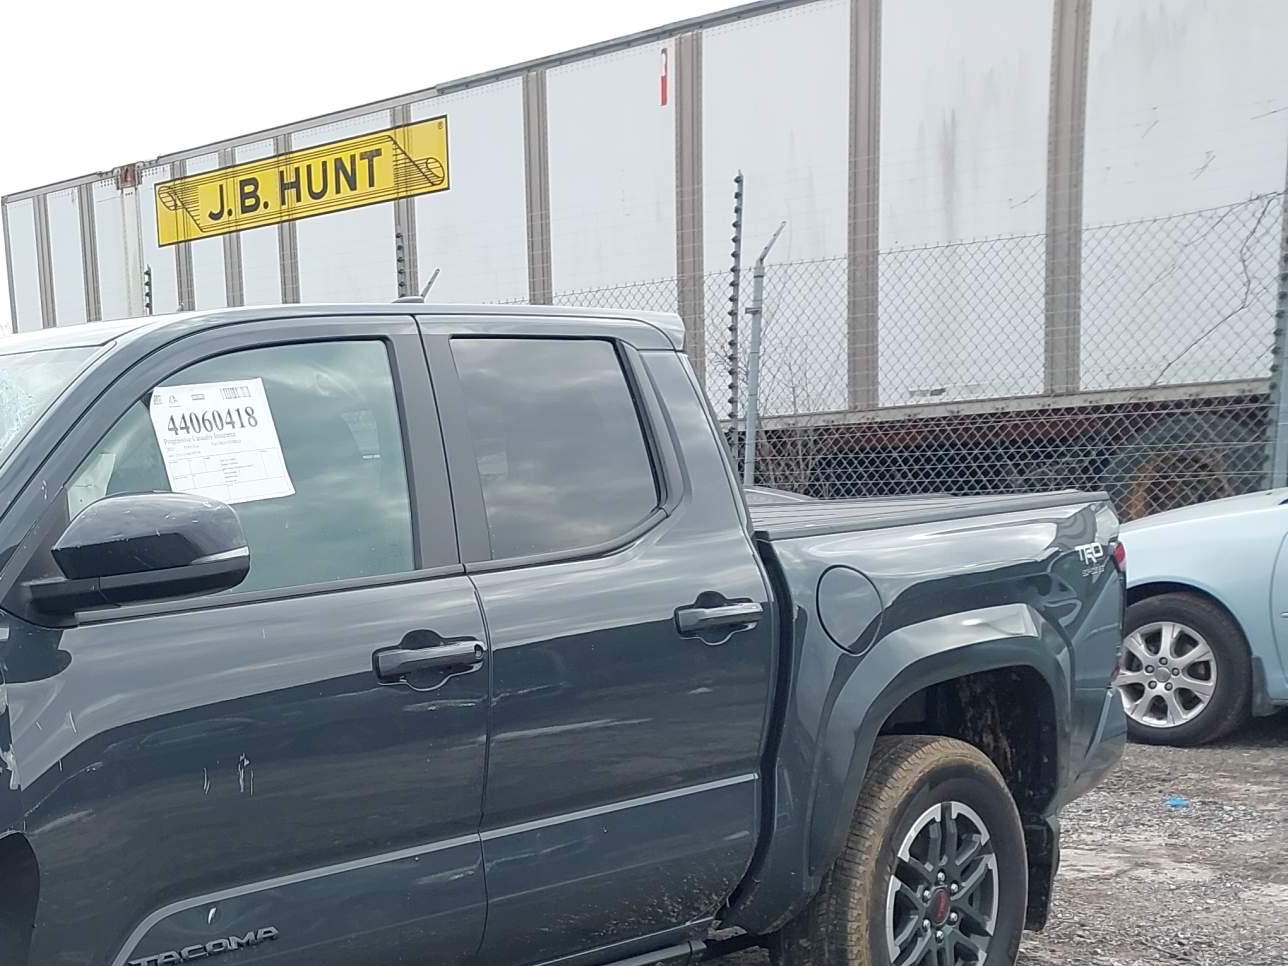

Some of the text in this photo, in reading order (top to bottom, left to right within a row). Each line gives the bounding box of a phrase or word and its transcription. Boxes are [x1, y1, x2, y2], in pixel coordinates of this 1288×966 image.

[207, 147, 383, 221] J.B. HUNT
[167, 406, 258, 436] 44060418
[1074, 542, 1104, 565] TRD
